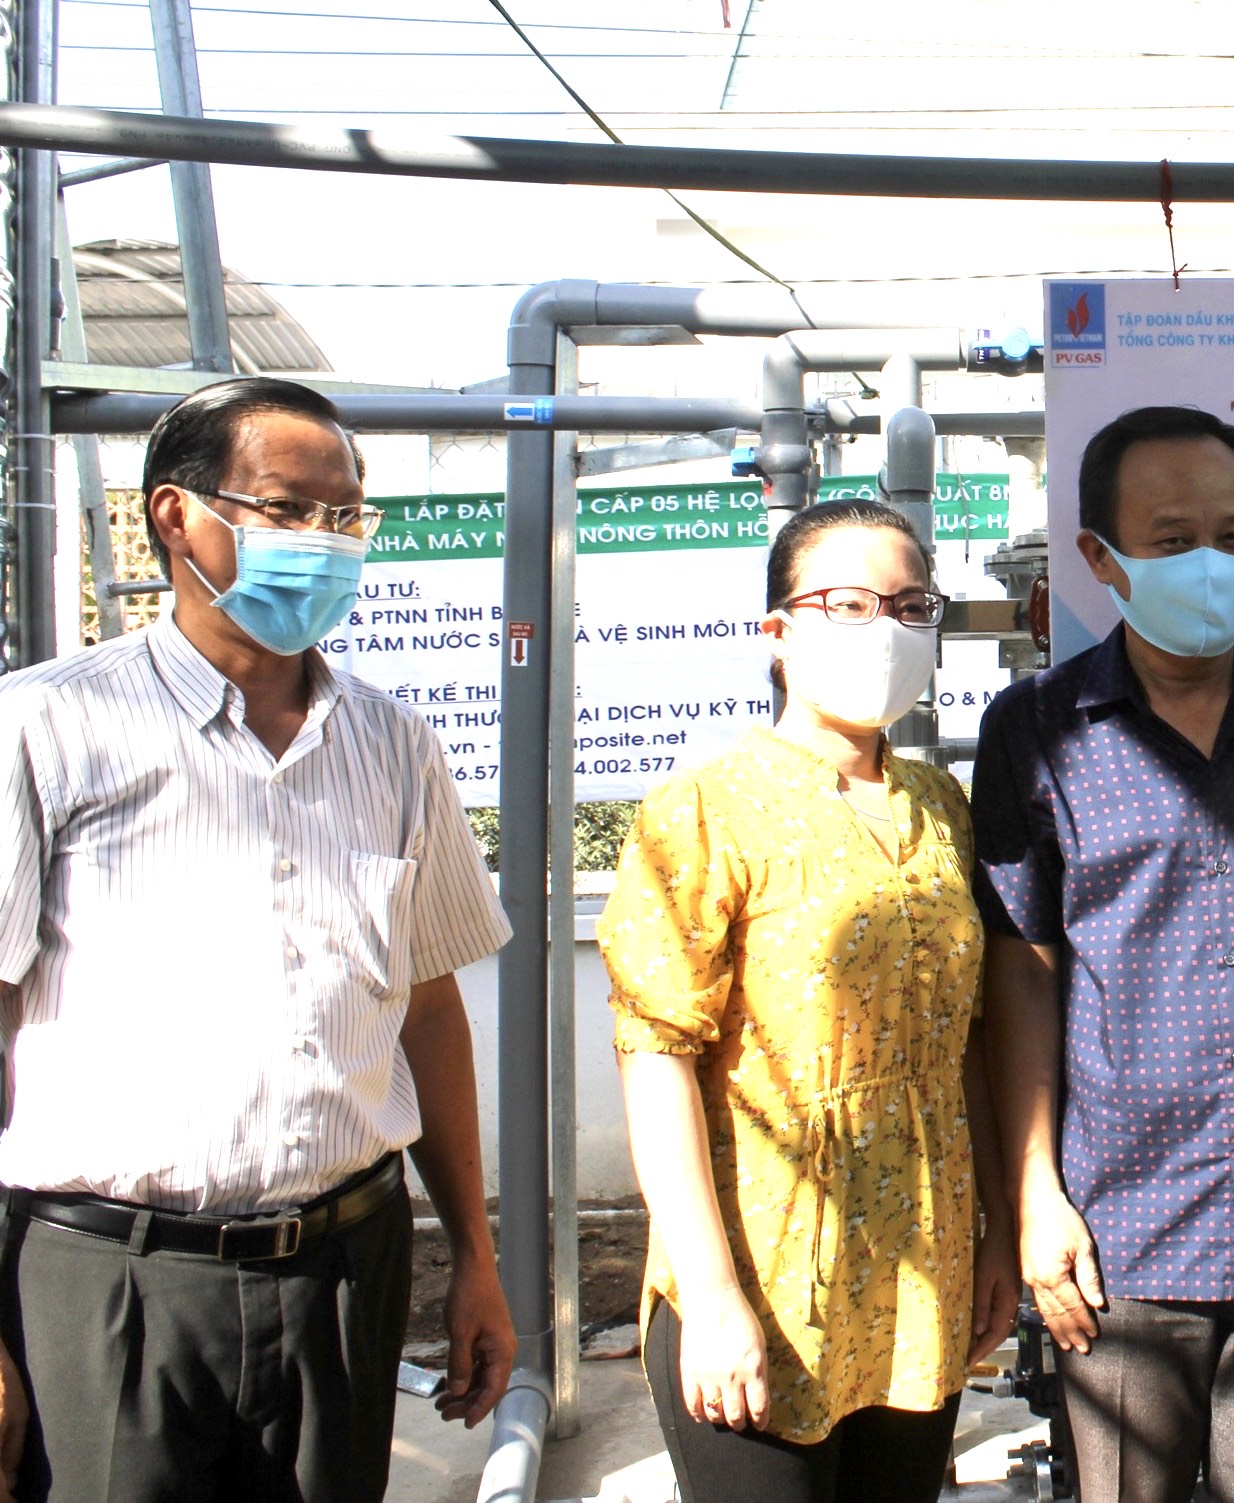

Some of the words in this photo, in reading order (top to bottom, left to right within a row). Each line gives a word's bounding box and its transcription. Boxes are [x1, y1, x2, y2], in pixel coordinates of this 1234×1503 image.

[1117, 312, 1142, 329] TẬP
[1146, 312, 1182, 327] ĐOÀN
[1117, 330, 1154, 347] TỔNG
[1158, 331, 1195, 347] CÔNG
[1199, 335, 1215, 346] TY
[1055, 353, 1074, 364] PV
[1075, 352, 1102, 364] GAS
[404, 499, 449, 521] LẮP
[458, 500, 505, 522] ĐẶT
[591, 492, 644, 514] CẤP
[651, 495, 679, 512] 05
[688, 490, 720, 513] HỆ
[730, 492, 765, 511] LỌ
[369, 530, 420, 552] NHÀ
[428, 528, 487, 550] MÁY
[580, 523, 656, 543] NÔNG
[663, 520, 729, 540] THÔN
[387, 580, 420, 598] TƯ:
[349, 611, 364, 626] &
[372, 609, 427, 625] PTNN
[435, 602, 483, 623] TỈNH
[355, 634, 404, 652] TÂM
[413, 631, 481, 650] NƯỚC
[598, 624, 628, 644] VỆ
[636, 625, 685, 641] SINH
[694, 620, 736, 638] MÔI
[429, 681, 457, 702] KẾ
[465, 686, 496, 700] THI
[454, 709, 501, 728] THƯ
[574, 707, 599, 725] ẠI
[608, 704, 661, 723] DỊCH
[669, 703, 700, 720] VỤ
[710, 698, 737, 717] KỸ
